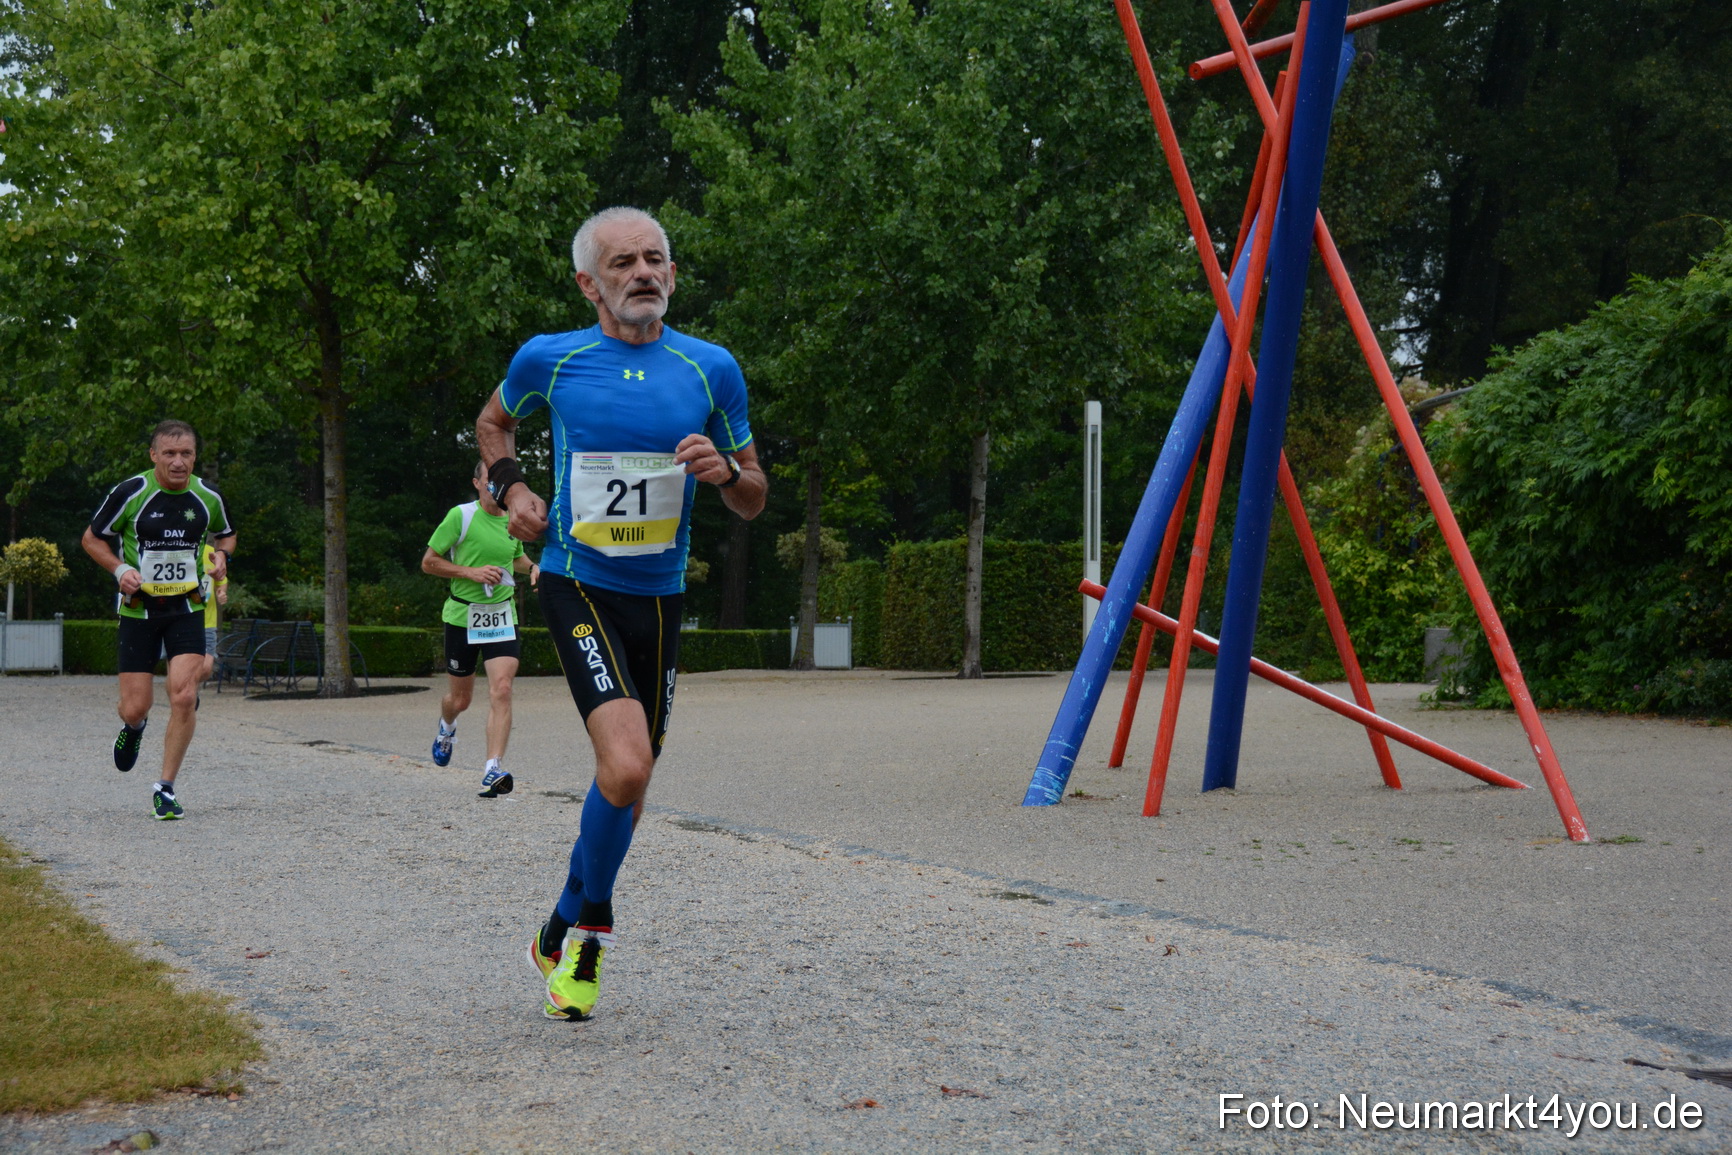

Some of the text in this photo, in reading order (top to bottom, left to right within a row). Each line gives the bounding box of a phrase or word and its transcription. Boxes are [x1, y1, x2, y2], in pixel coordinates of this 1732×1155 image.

[621, 456, 674, 469] BOCK
[606, 478, 648, 516] 21
[164, 529, 186, 538] DAV
[610, 526, 645, 542] Willi
[153, 562, 187, 581] 235
[153, 585, 187, 593] Reinhard
[473, 611, 507, 628] 2361
[578, 635, 614, 693] SKINS
